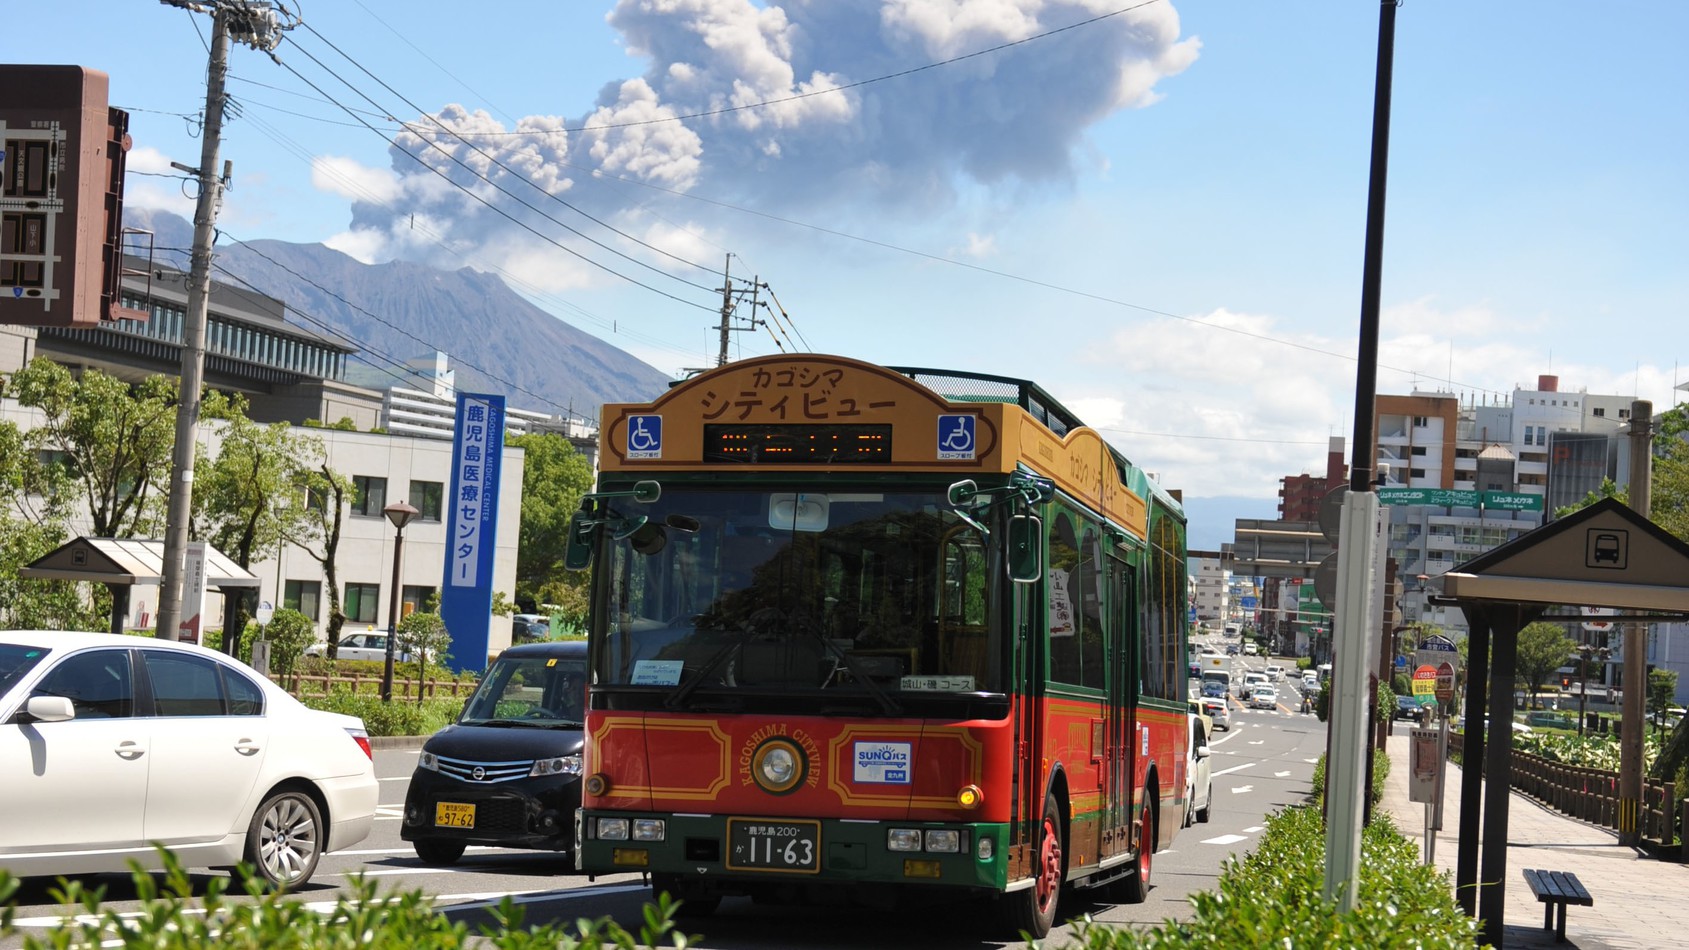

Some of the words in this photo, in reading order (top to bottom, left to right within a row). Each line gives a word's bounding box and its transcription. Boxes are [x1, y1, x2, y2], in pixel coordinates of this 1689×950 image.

[29, 223, 37, 247] 山下小
[753, 367, 844, 388] カゴシマ
[701, 390, 896, 420] シティビュー
[486, 408, 497, 454] KAGOSHIMA
[1554, 447, 1570, 464] P
[484, 456, 494, 490] MEDICAL
[457, 404, 485, 579] 鹿児島医療センター
[482, 492, 491, 521] CENTER
[941, 680, 971, 690] コース
[739, 723, 787, 787] KAGOSHIMA
[444, 812, 473, 826] 97-62
[750, 837, 813, 865] 11-63
